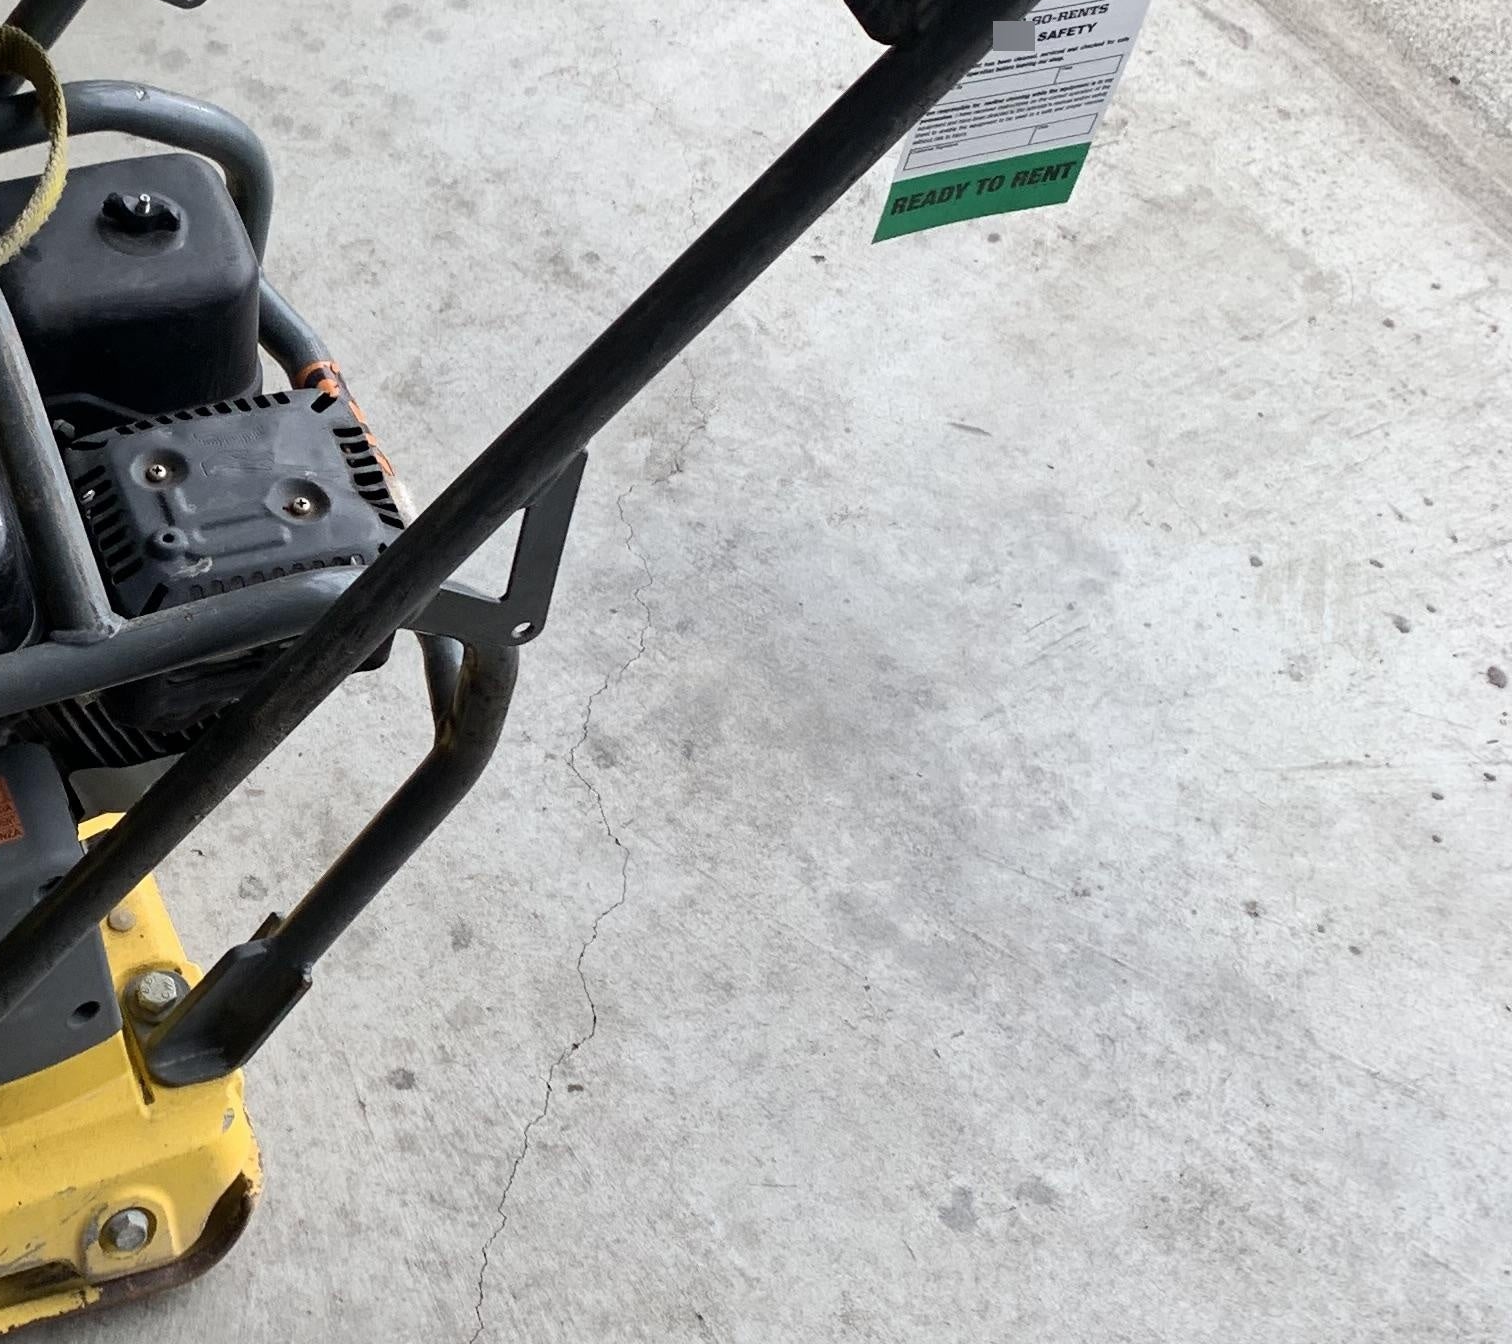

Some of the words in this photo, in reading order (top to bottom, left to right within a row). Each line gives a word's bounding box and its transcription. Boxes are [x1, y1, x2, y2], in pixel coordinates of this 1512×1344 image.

[1036, 22, 1099, 42] SAFETY
[890, 181, 971, 216] READY
[976, 174, 1006, 196] TO
[1010, 161, 1078, 188] RENT
